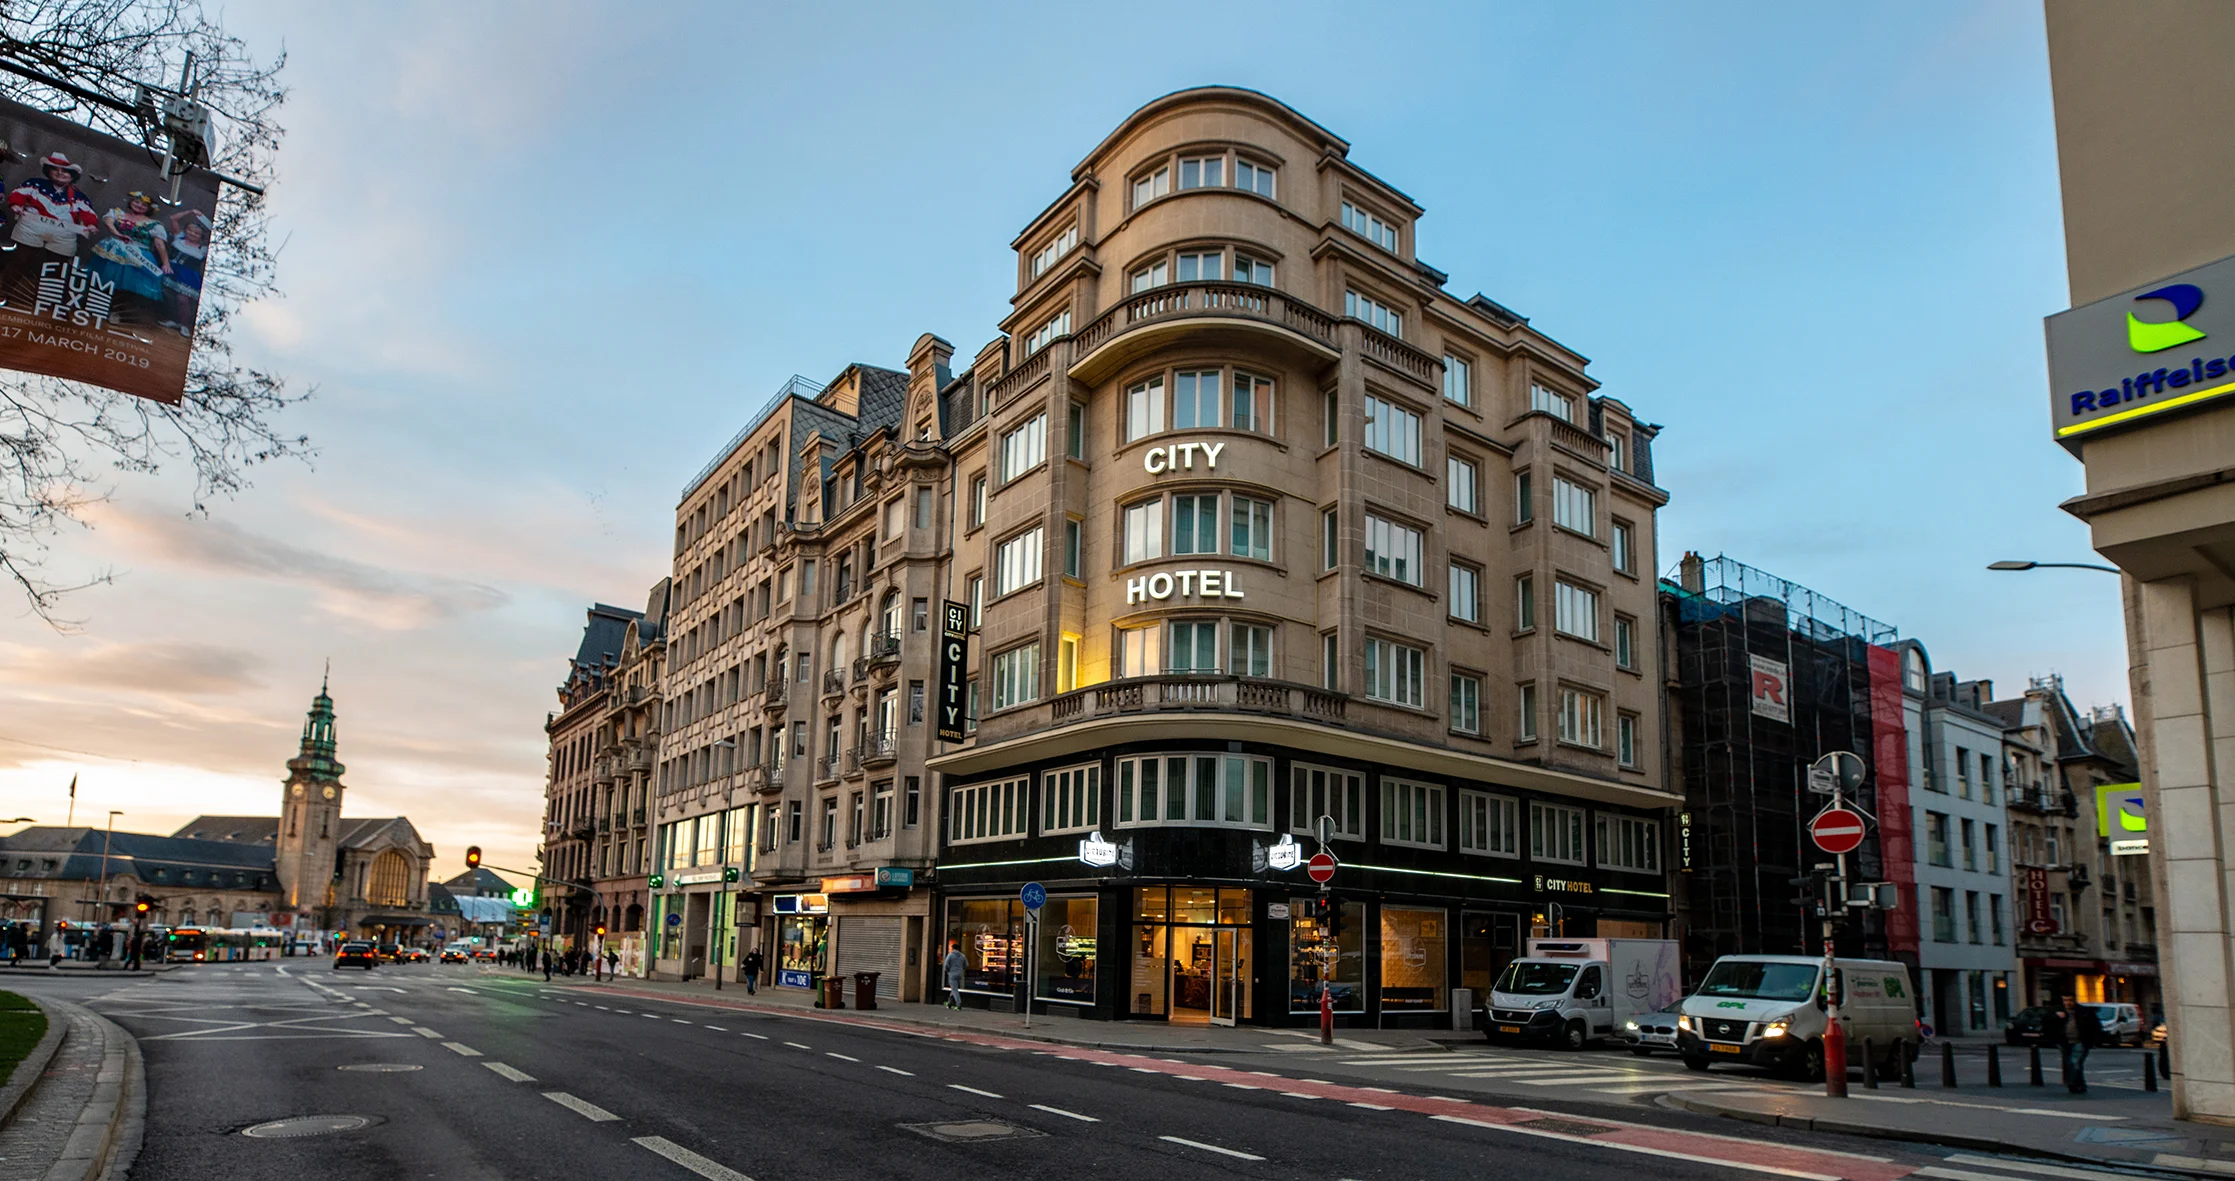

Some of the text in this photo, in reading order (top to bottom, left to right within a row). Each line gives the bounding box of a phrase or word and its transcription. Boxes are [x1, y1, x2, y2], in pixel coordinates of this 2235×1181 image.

[40, 216, 66, 229] USA
[41, 255, 115, 296] FILM
[125, 244, 159, 275] GERMANY
[33, 300, 108, 330] FEST
[1, 326, 150, 369] 17 MARCH 2019
[55, 325, 77, 335] CITY
[80, 330, 104, 342] FILM
[103, 336, 150, 355] FESTIVAL
[2071, 354, 2235, 416] Raiffeis
[1144, 442, 1225, 475] CITY
[1126, 569, 1245, 605] HOTEL
[946, 643, 961, 726] CITY
[1753, 670, 1785, 706] R
[939, 729, 963, 740] HOTEL
[1681, 828, 1691, 867] CITY
[2030, 870, 2045, 920] HOTEL
